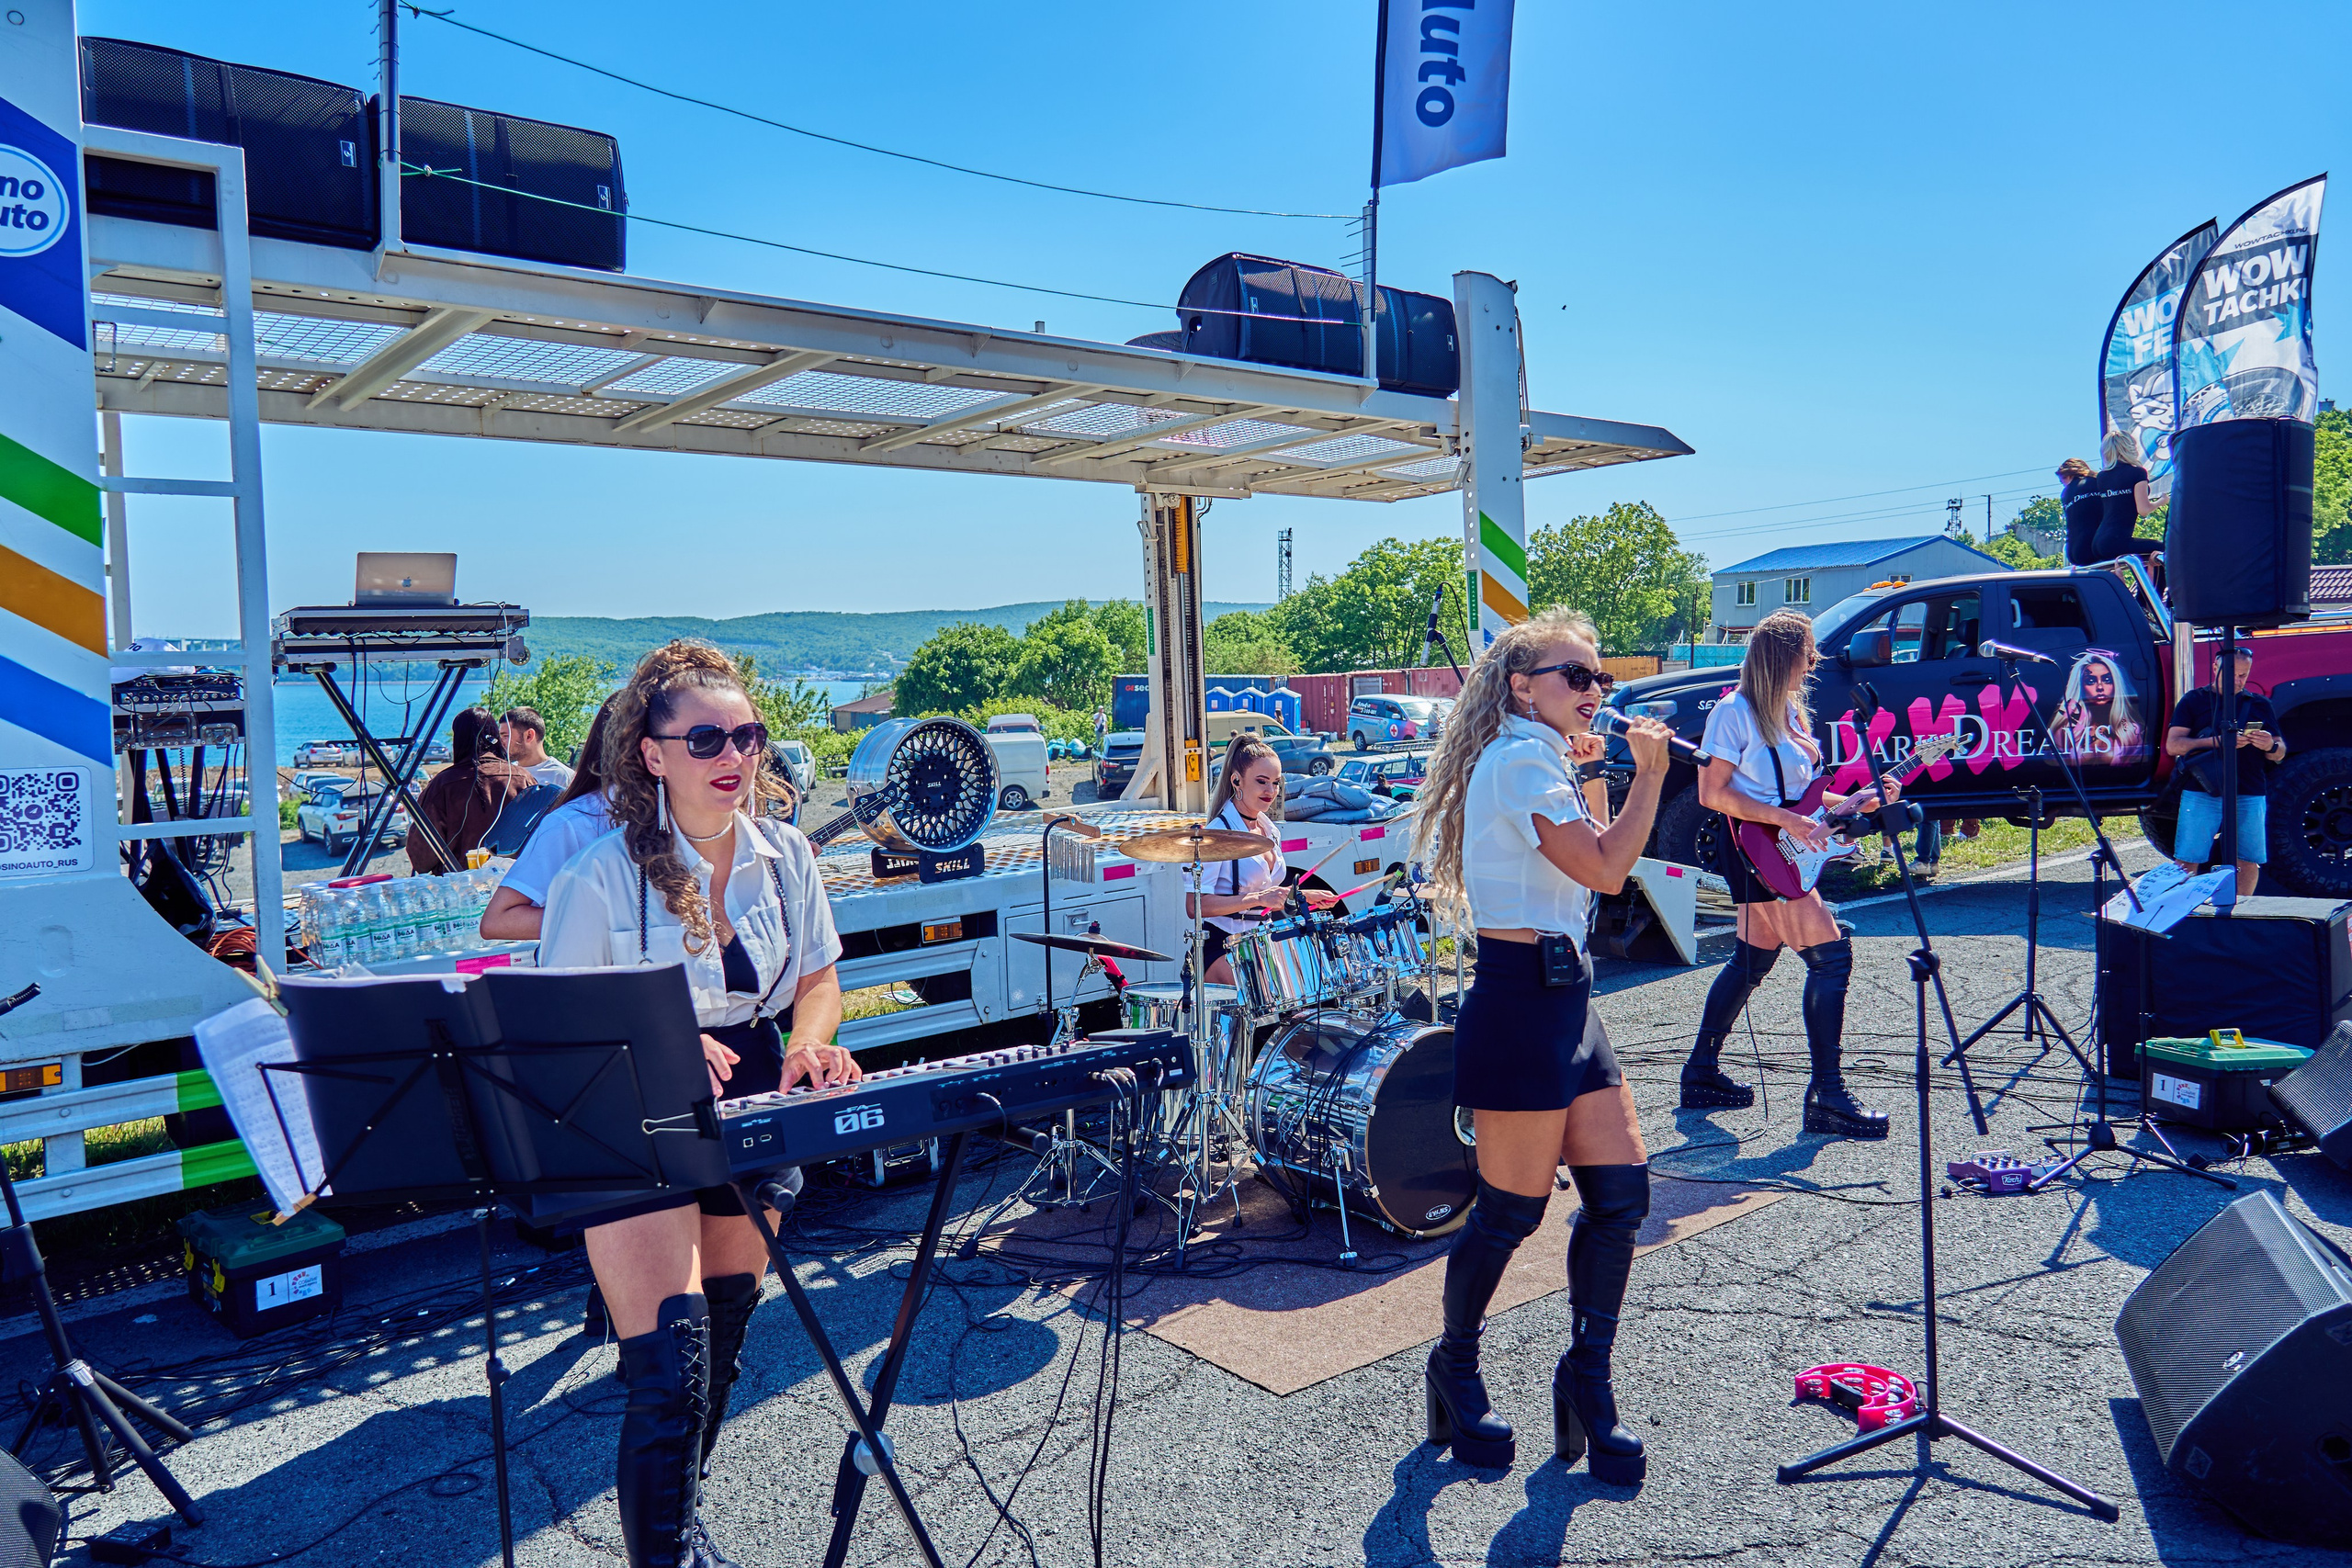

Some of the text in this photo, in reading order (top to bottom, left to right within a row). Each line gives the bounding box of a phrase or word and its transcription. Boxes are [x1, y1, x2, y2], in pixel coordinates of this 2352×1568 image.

[1416, 0, 1476, 128] uto
[2202, 244, 2309, 299] WOW
[2121, 288, 2184, 337] WO
[2203, 277, 2307, 326] TACHKI
[0, 859, 78, 871] SINOAUTO_RUS
[934, 857, 970, 874] SKILL
[834, 1108, 885, 1135] 06
[268, 1281, 277, 1297] 1
